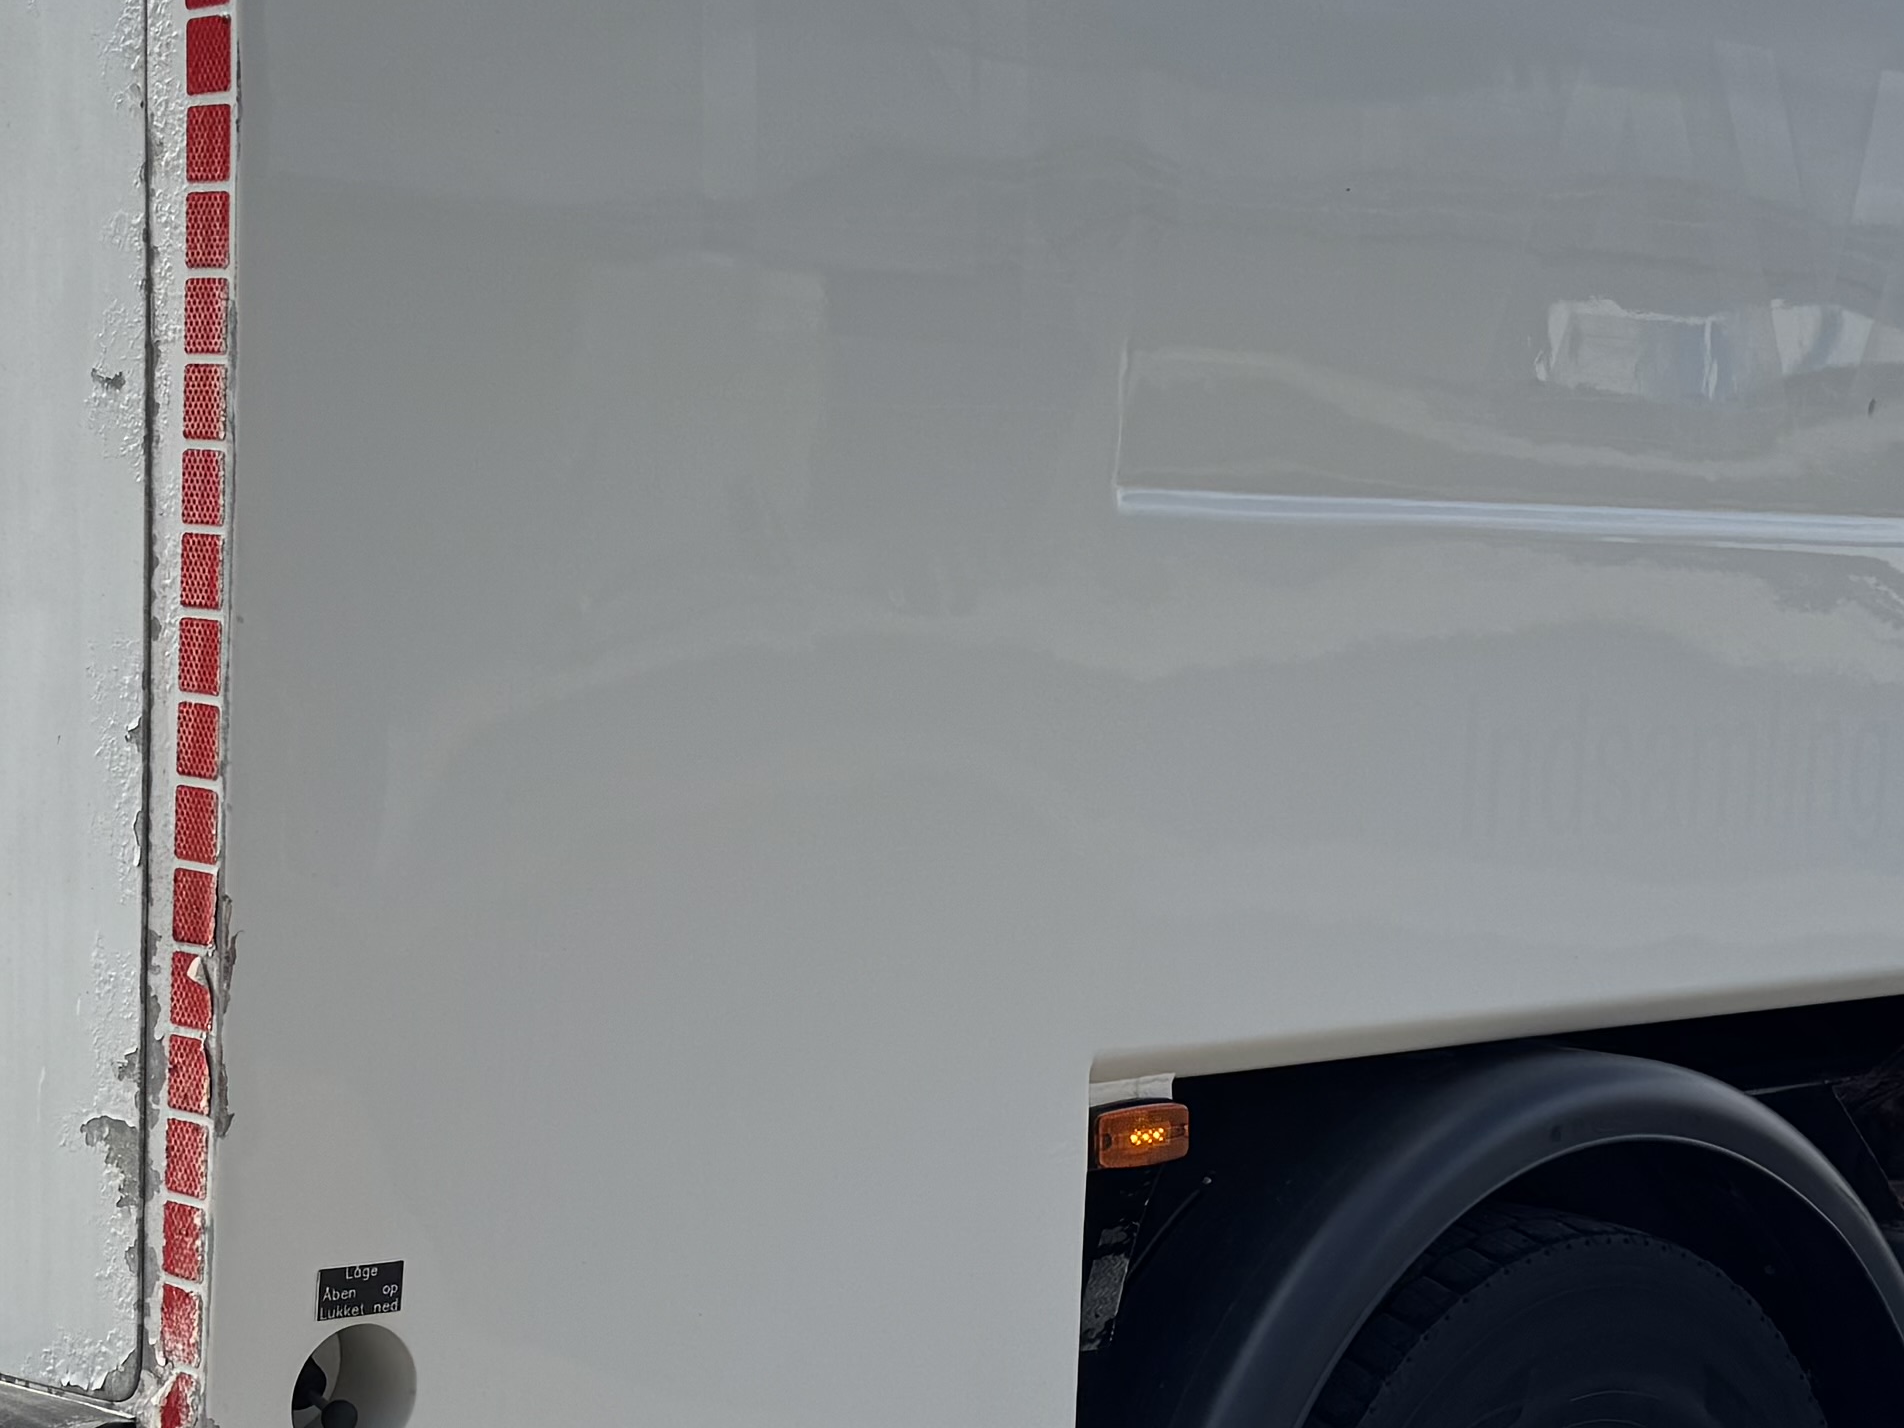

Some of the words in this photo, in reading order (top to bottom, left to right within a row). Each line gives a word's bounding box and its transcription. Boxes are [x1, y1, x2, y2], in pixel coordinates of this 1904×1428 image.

[322, 1286, 357, 1302] Åben
[382, 1284, 399, 1298] op
[373, 1298, 399, 1313] ned
